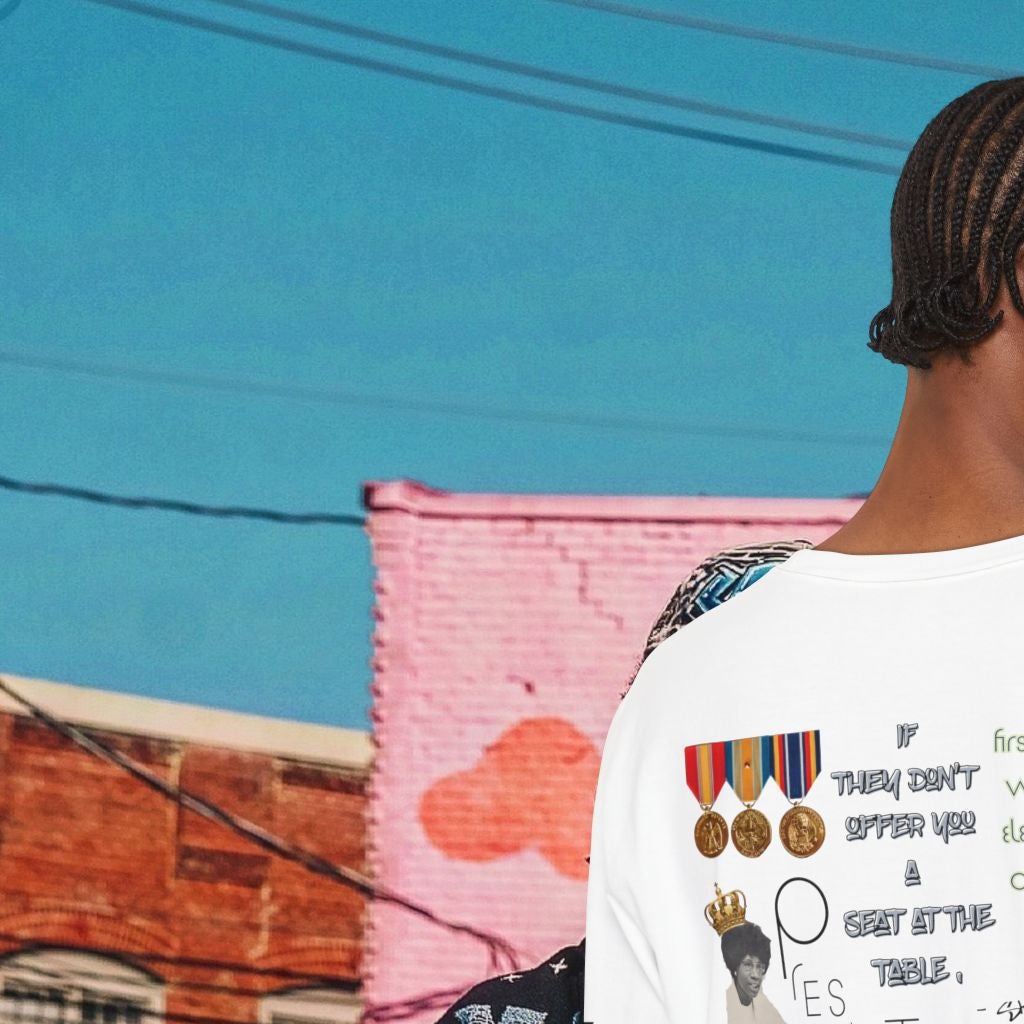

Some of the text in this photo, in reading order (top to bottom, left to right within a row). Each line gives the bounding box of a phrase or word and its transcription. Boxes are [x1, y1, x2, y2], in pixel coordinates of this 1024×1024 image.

[896, 723, 919, 749] IF
[831, 762, 981, 801] THEY DON'T
[845, 812, 926, 842] OFFER
[931, 811, 977, 845] YOU
[904, 859, 922, 887] A
[843, 903, 997, 938] SEAT AT THE
